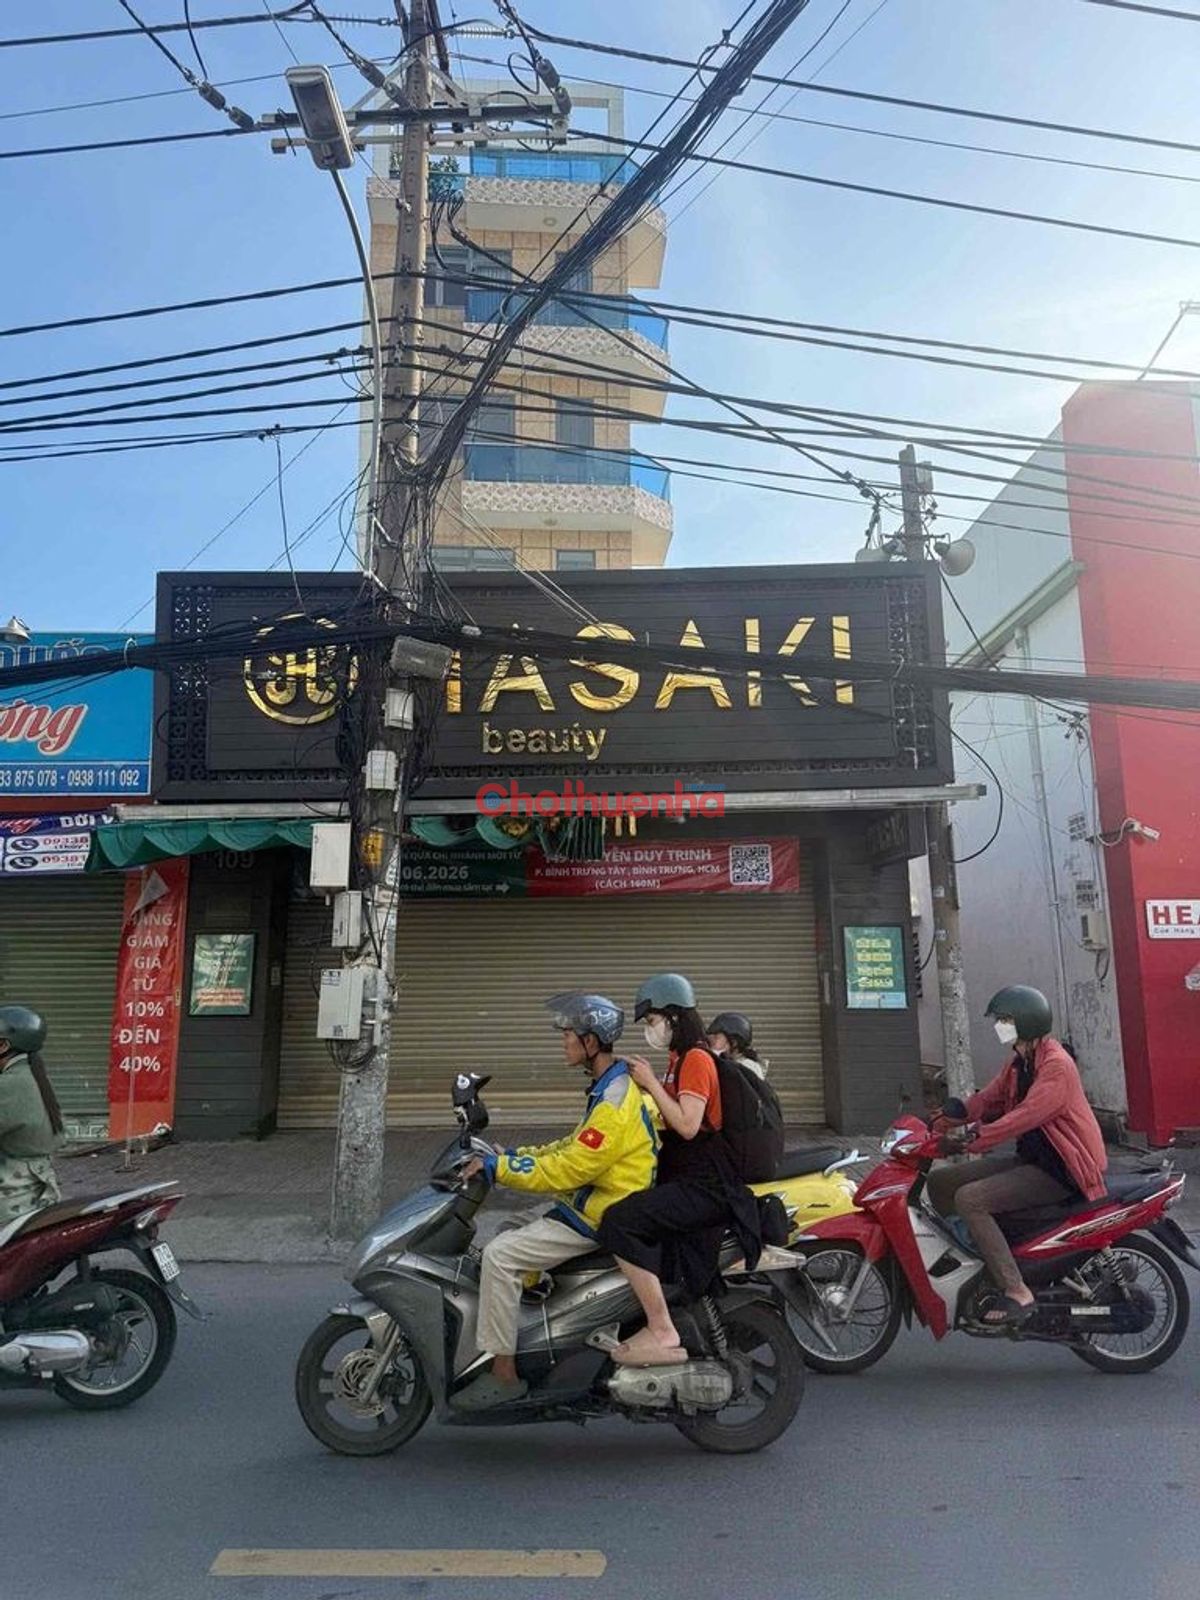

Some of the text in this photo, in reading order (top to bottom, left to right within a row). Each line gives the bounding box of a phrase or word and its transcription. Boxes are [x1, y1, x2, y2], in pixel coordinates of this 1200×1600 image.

[481, 722, 607, 760] beauty
[15, 770, 35, 787] 875
[38, 770, 58, 786] 078
[67, 769, 94, 786] 0938
[98, 769, 116, 786] 111
[120, 769, 140, 786] 092
[634, 850, 663, 862] DUY
[1152, 905, 1200, 925] HE
[134, 952, 162, 970] GIÁ
[125, 1002, 164, 1017] 10%
[119, 1024, 160, 1044] ĐẾN
[119, 1055, 161, 1072] 40%
